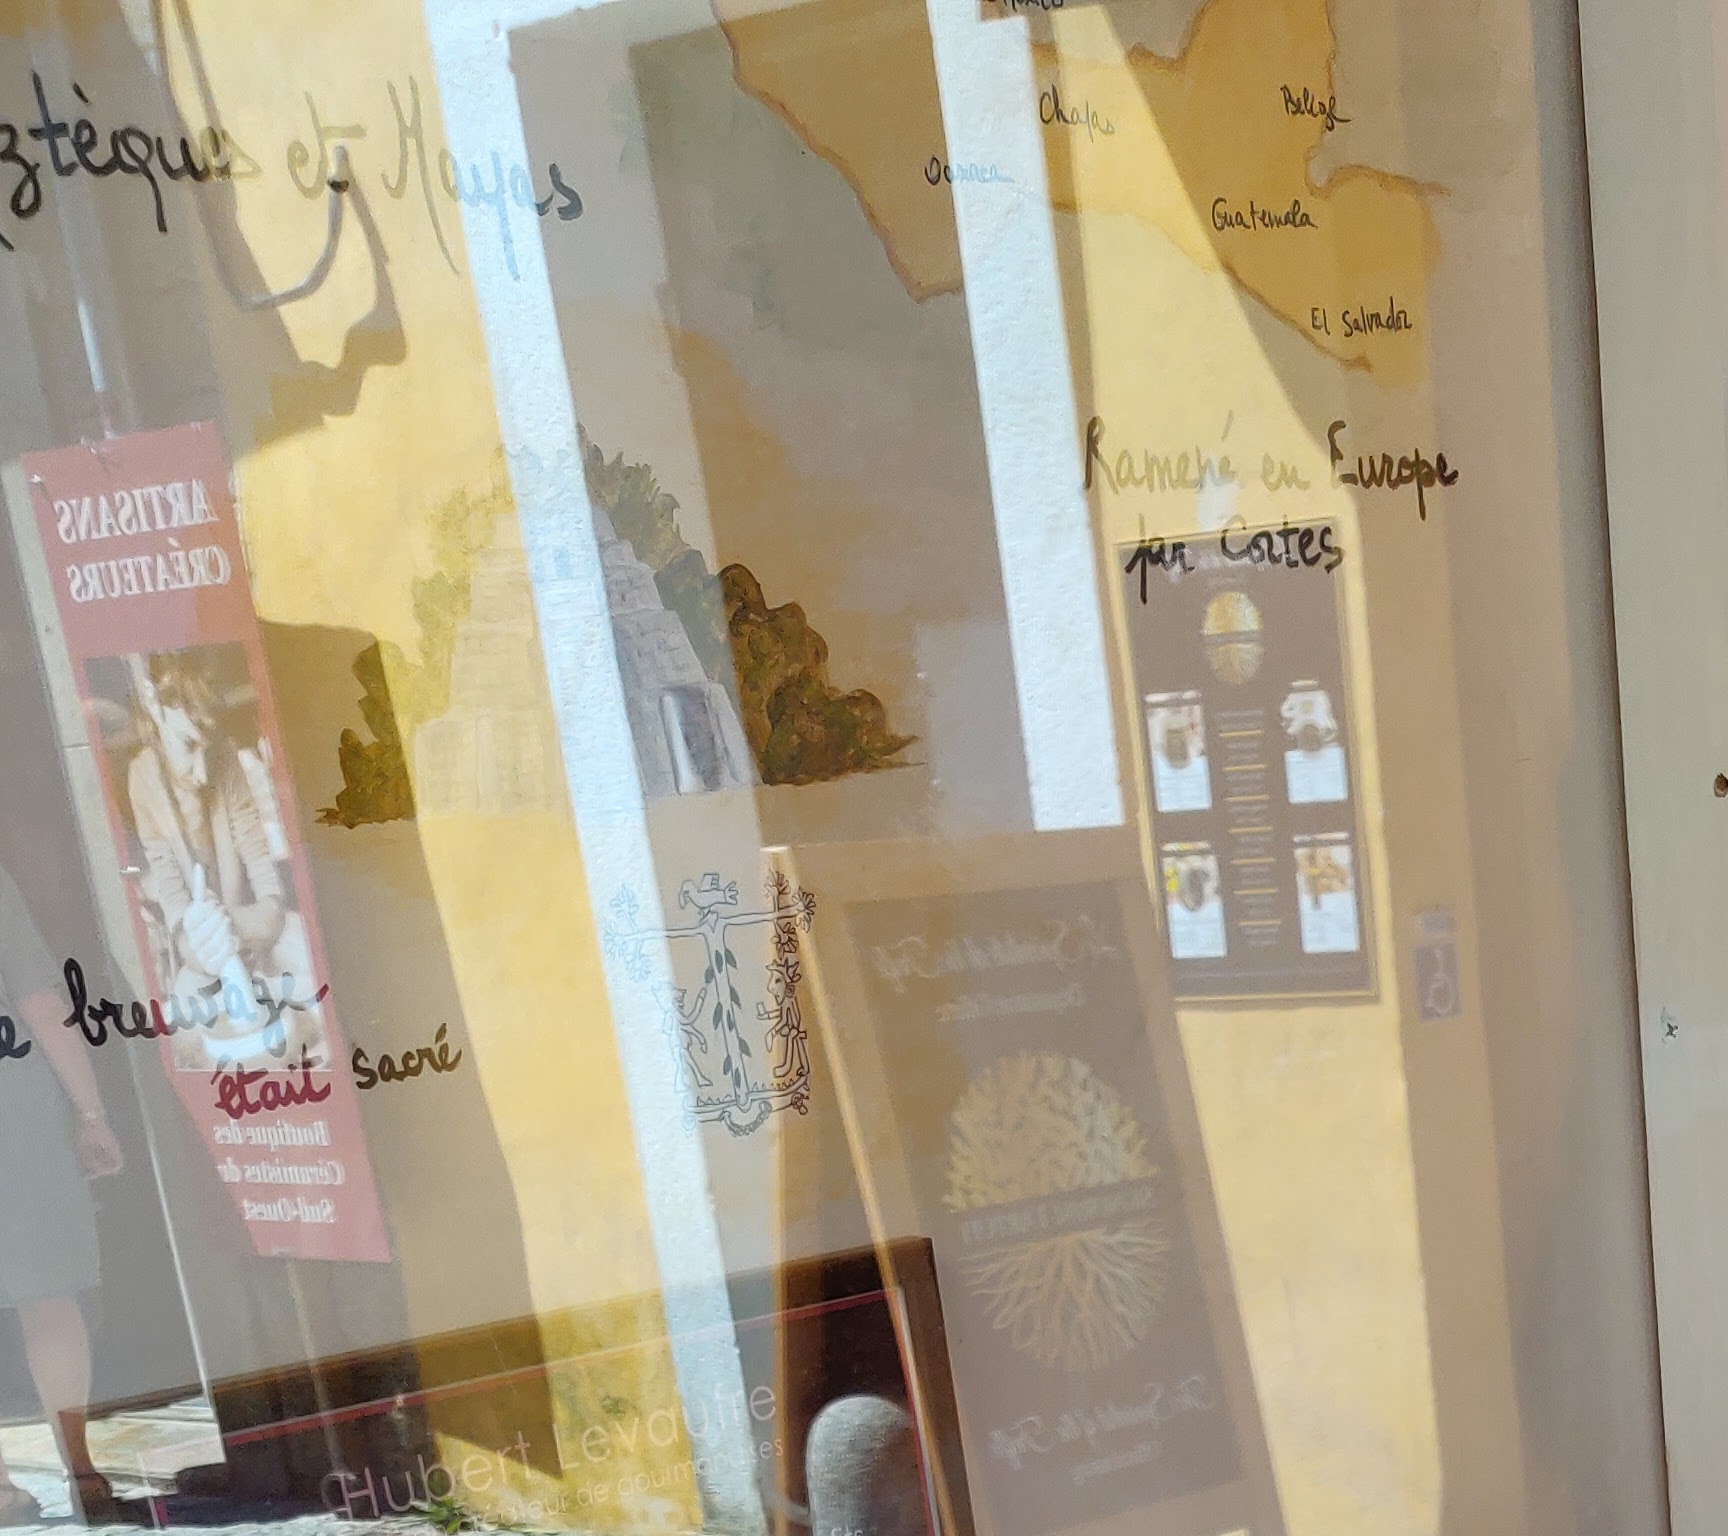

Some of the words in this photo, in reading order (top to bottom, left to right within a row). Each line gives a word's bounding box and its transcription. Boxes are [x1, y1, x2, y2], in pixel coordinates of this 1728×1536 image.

[287, 91, 366, 200] et
[381, 75, 583, 282] Mayas
[1211, 197, 1318, 232] Guatemala
[1310, 307, 1330, 336] El
[1341, 295, 1413, 338] Salvador
[1262, 450, 1311, 492] en
[1328, 419, 1459, 521] Europe
[1125, 513, 1196, 605] par
[1220, 514, 1345, 573] Cortes
[211, 1042, 332, 1120] était
[352, 1022, 462, 1090] sacré
[340, 1431, 531, 1519] Hubert
[577, 1480, 609, 1506] de
